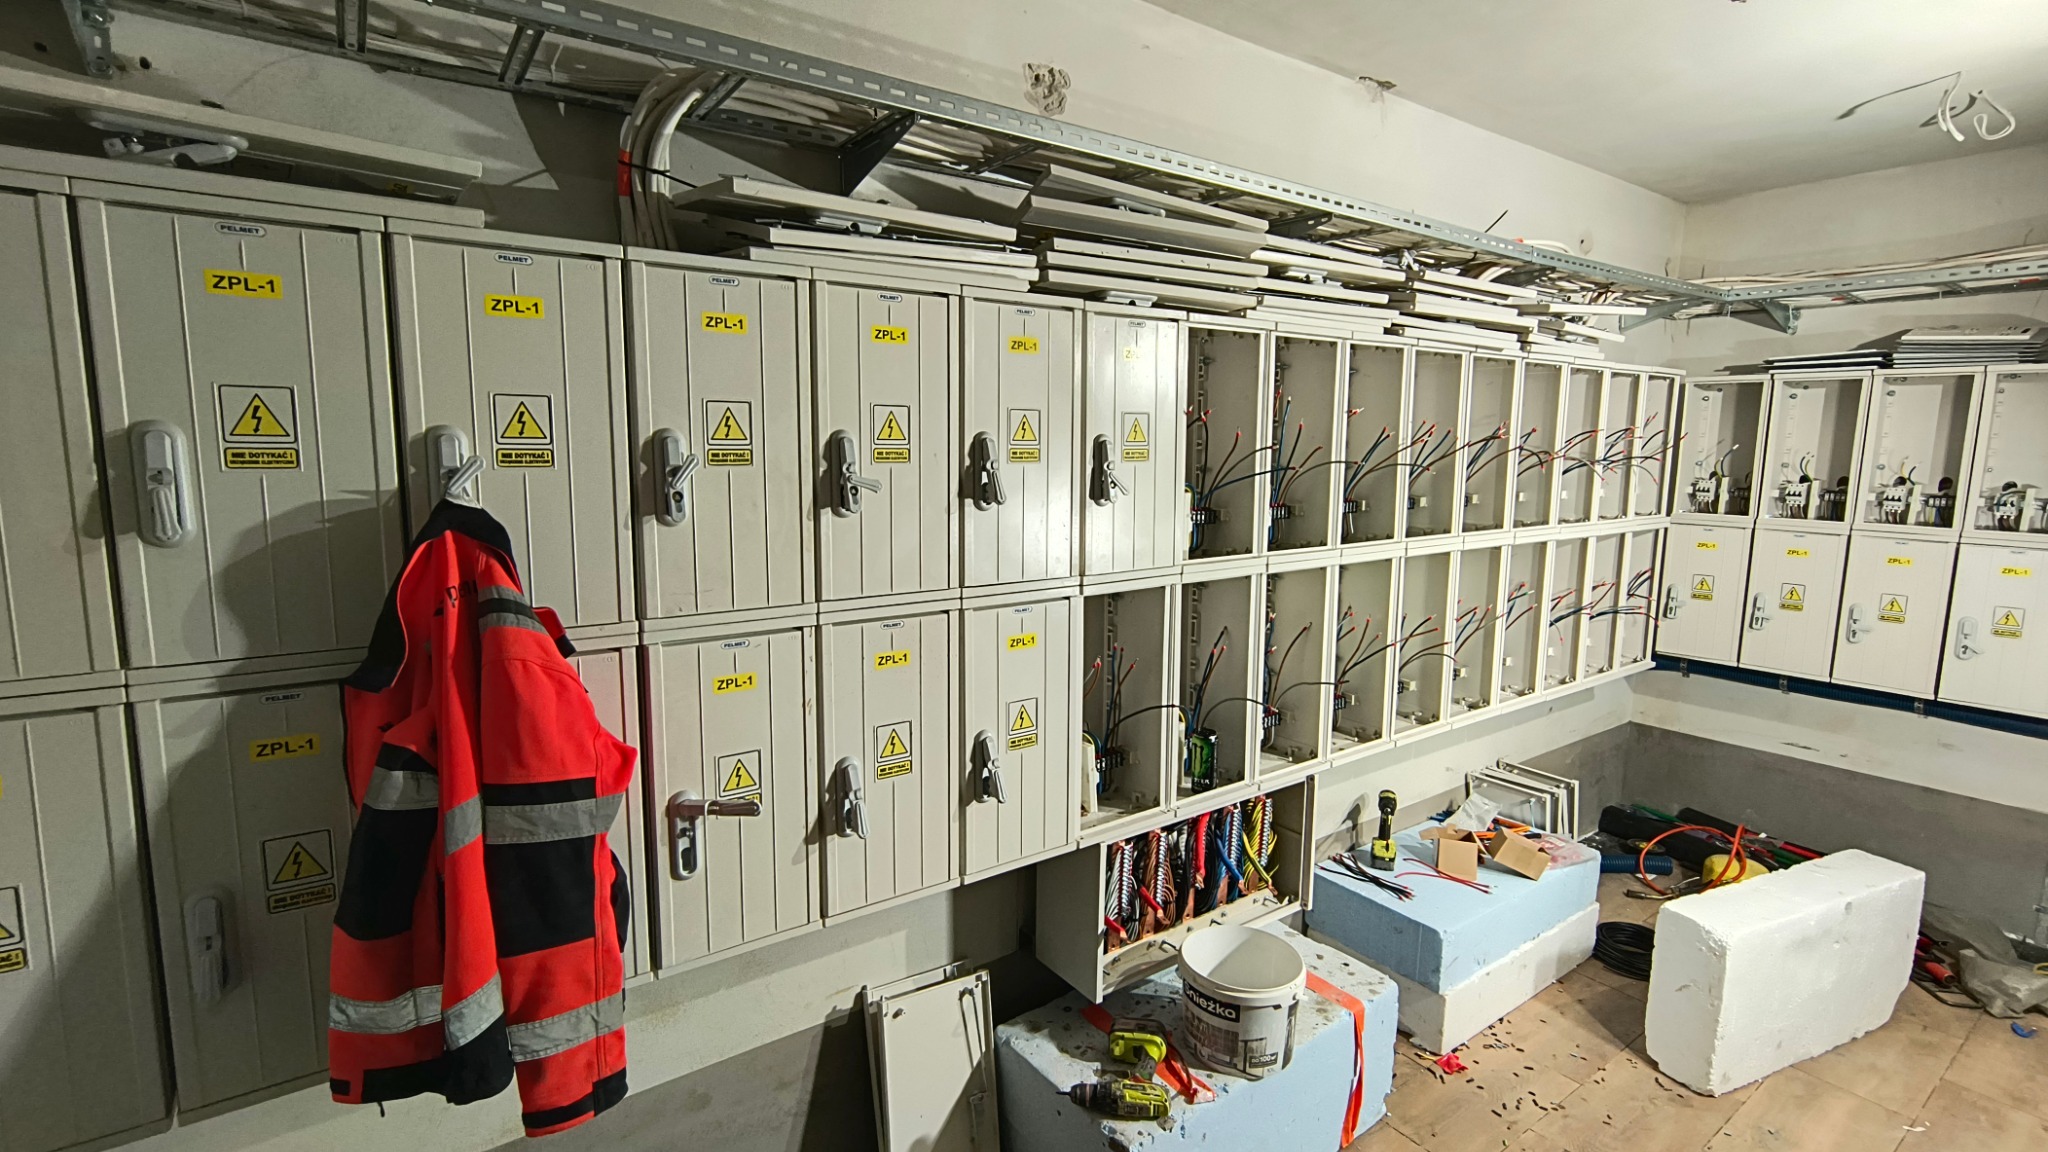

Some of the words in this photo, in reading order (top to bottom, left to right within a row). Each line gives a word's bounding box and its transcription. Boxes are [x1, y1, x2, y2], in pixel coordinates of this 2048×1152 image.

[220, 224, 260, 235] PELMET
[497, 254, 529, 263] PELMET
[212, 274, 275, 293] ZPL-1
[711, 277, 736, 285] PELMET
[491, 299, 539, 314] ZPL-1
[705, 316, 743, 330] ZPL-1
[874, 329, 906, 341] ZPL-1
[1010, 340, 1037, 351] ZPL-1
[1887, 557, 1911, 565] ZPL-1
[2001, 567, 2028, 575] ZPL-1
[723, 641, 747, 649] PELMET
[1010, 636, 1035, 648] ZPL-1
[878, 653, 907, 666] ZPL-1
[717, 675, 753, 691] ZPL-1
[256, 738, 314, 757] ZPL-1
